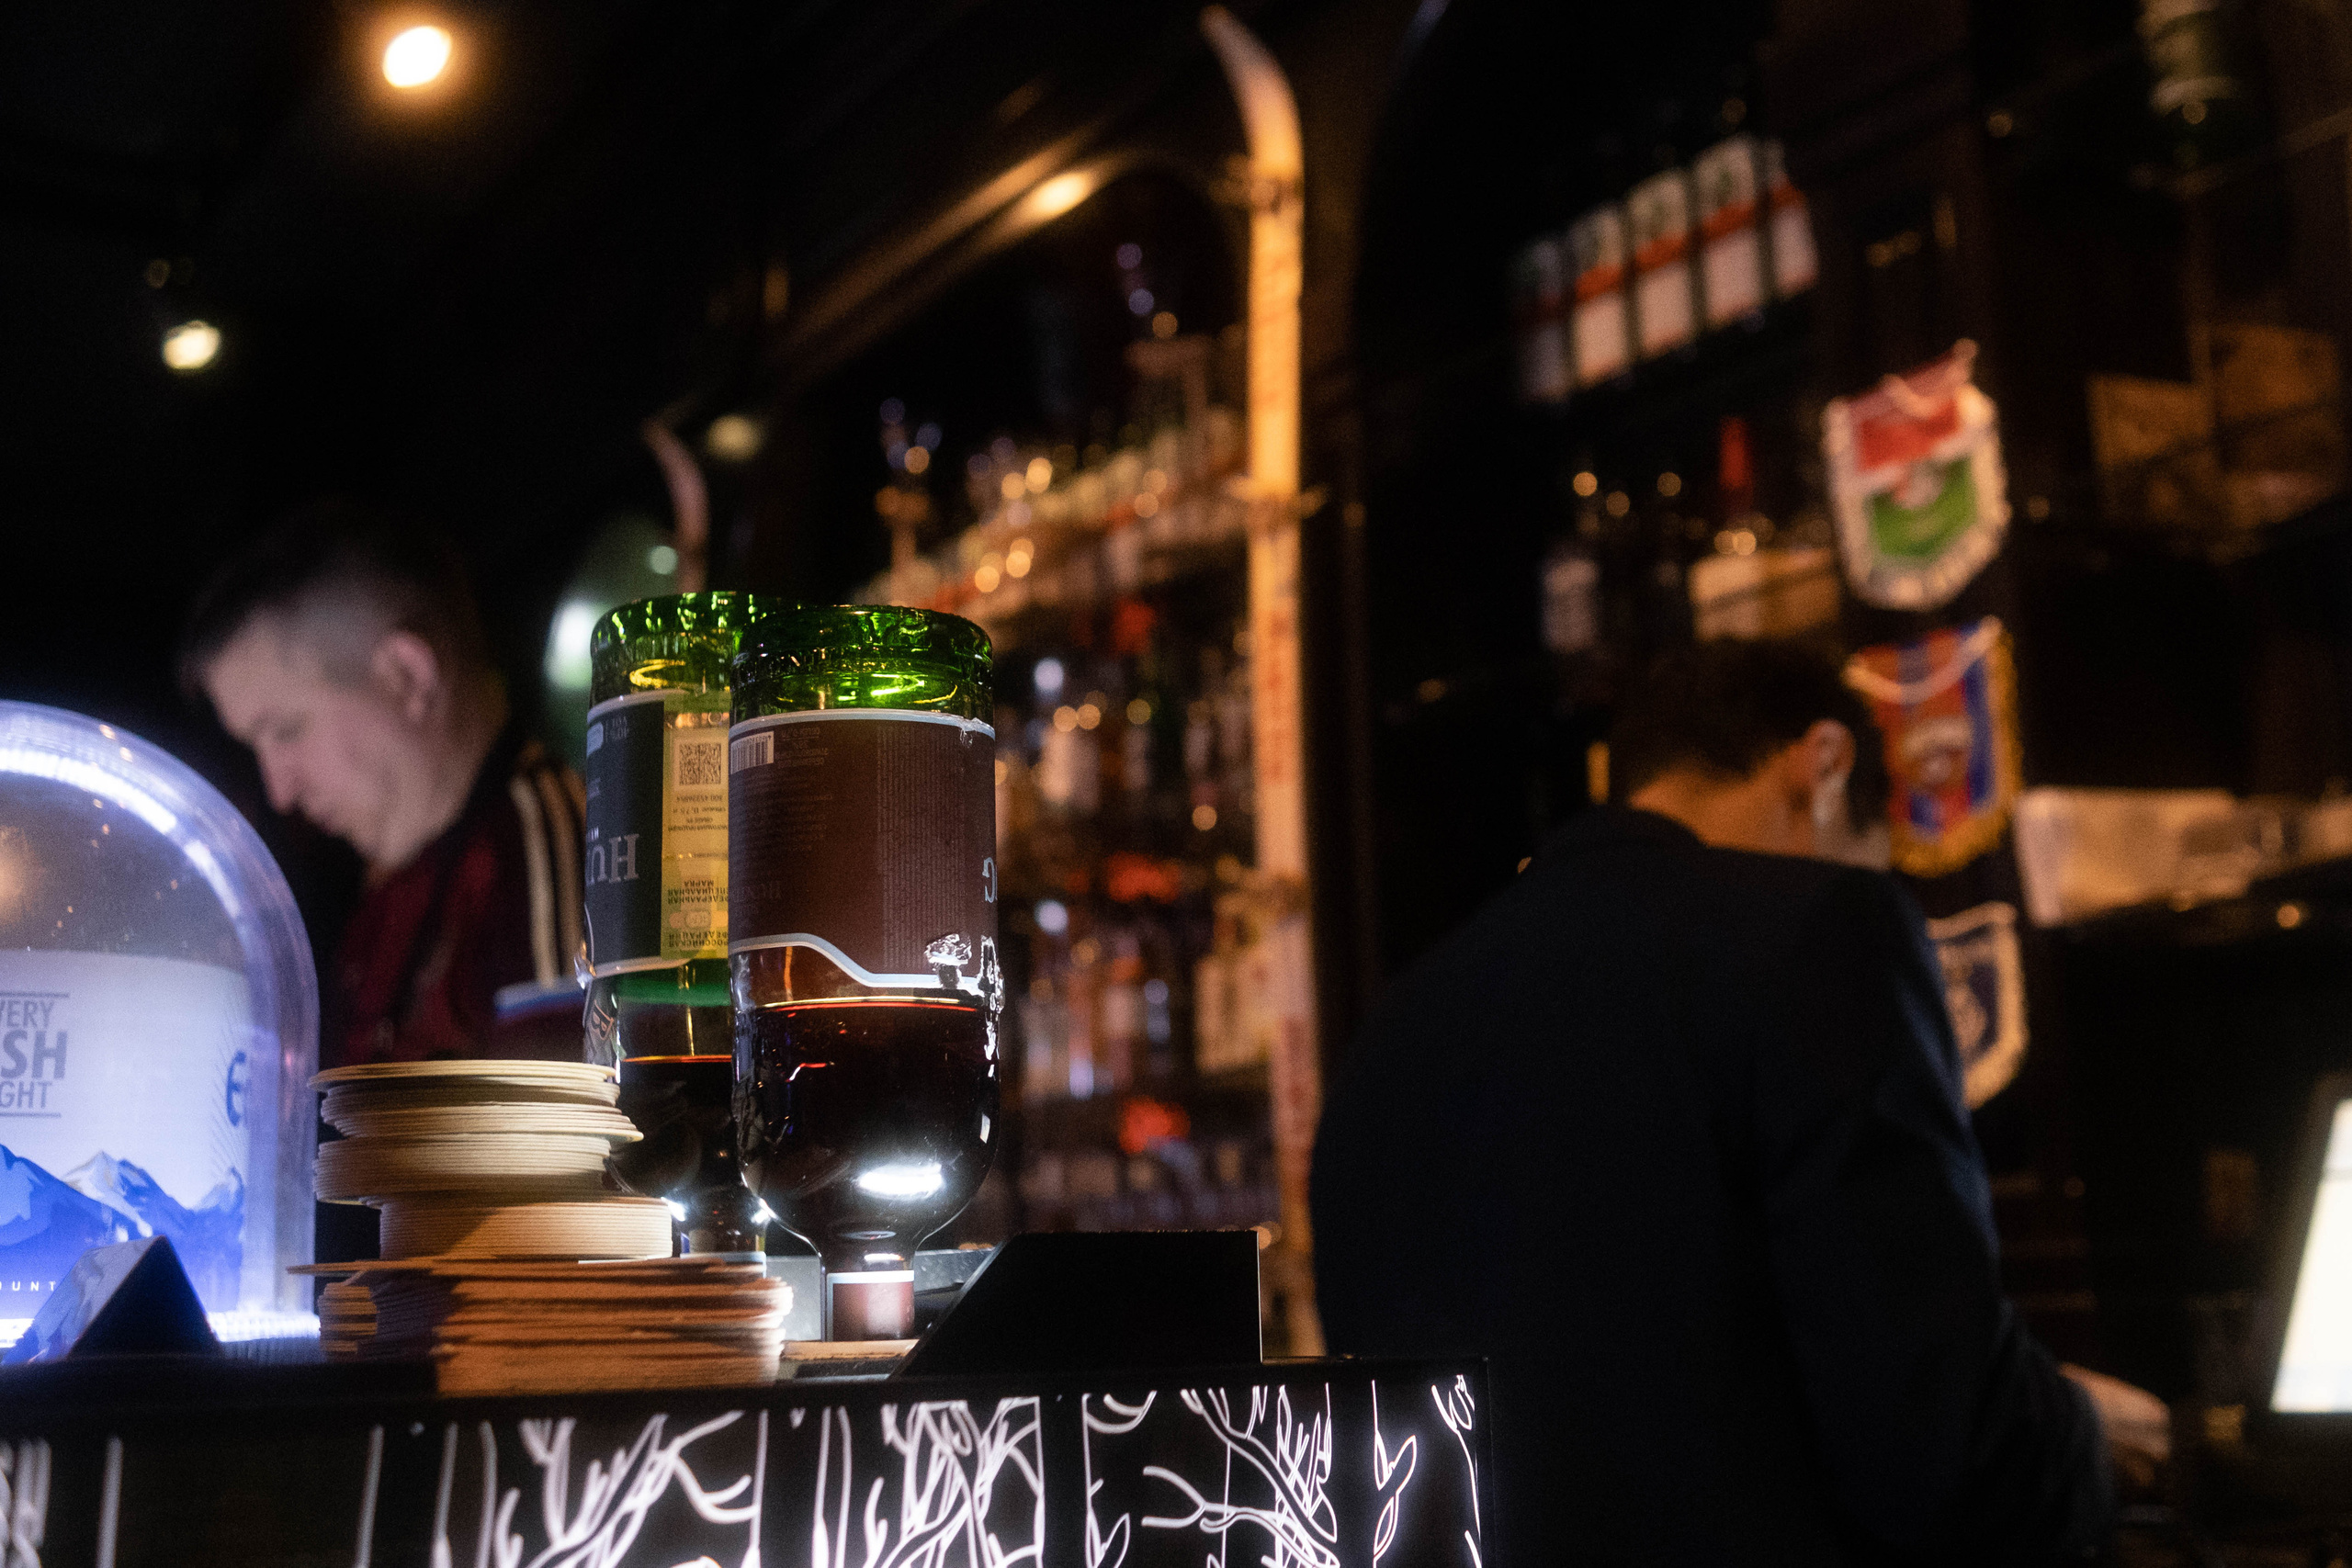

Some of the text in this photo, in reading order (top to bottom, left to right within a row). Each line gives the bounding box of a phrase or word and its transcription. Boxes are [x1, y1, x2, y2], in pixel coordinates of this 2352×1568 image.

[684, 880, 714, 888] МАРКА
[982, 857, 998, 903] G
[668, 887, 729, 897] ПЕЦИАЛЬНАЯ
[0, 1280, 56, 1292] UNT
